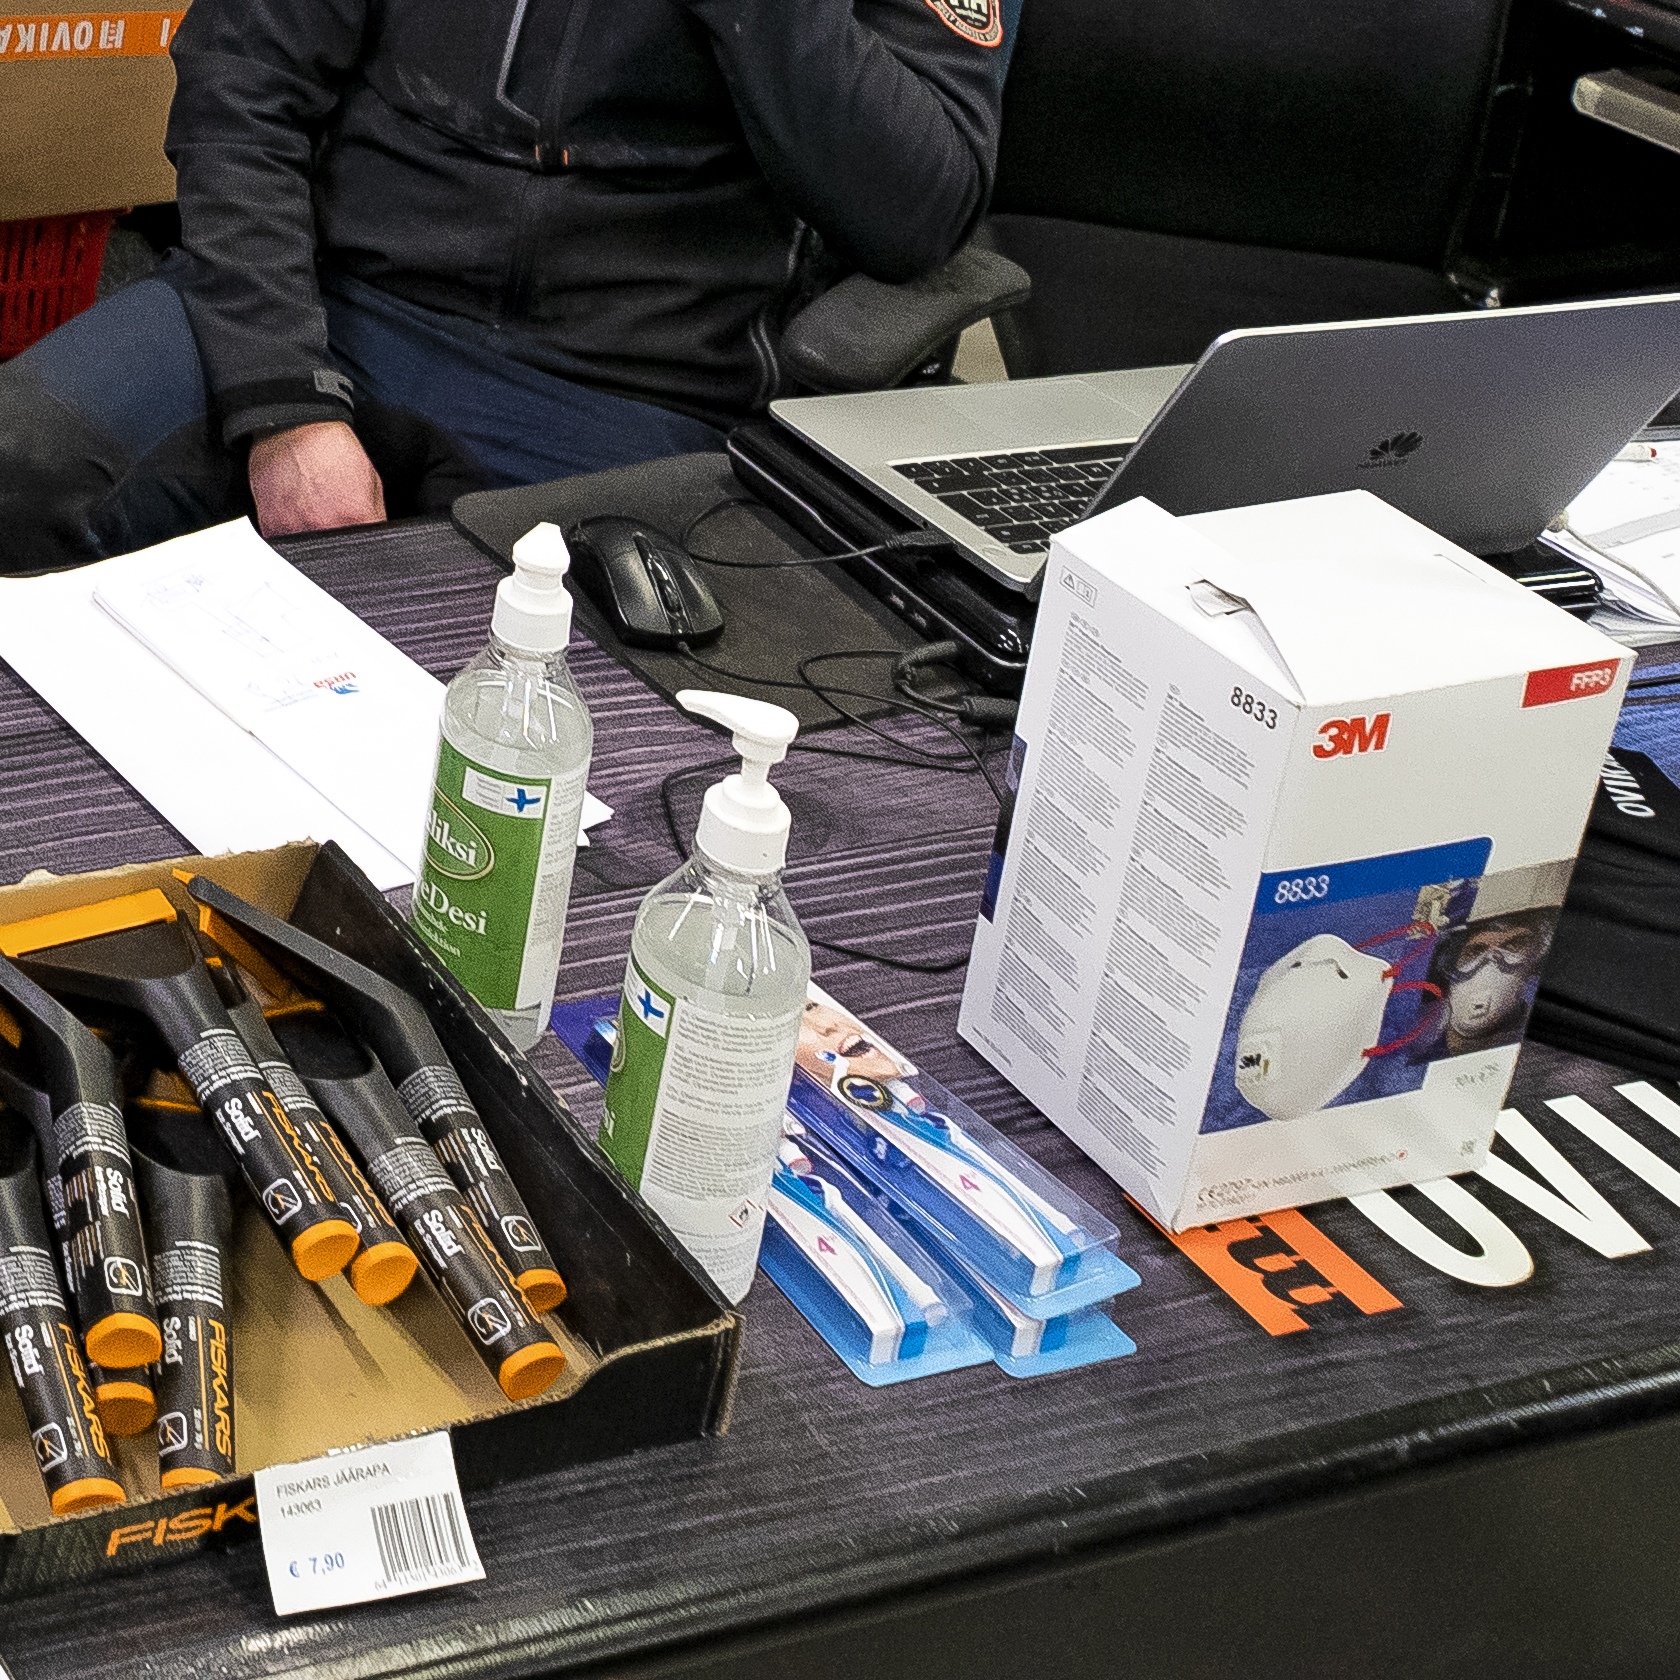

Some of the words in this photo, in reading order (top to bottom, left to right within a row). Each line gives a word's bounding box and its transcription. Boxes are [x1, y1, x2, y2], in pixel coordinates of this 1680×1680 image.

[1568, 666, 1614, 693] FFP3
[1229, 684, 1281, 731] 8833
[1311, 712, 1394, 761] 3M
[420, 880, 488, 936] eDesi
[1273, 873, 1331, 904] 8833
[224, 1097, 260, 1143] Solid
[104, 1167, 129, 1216] Solid
[13, 1324, 45, 1377] Solid
[58, 1323, 112, 1466] FISKARS
[163, 1316, 184, 1366] Solid
[208, 1318, 232, 1459] FISKARS
[275, 1475, 332, 1501] FISKARS
[333, 1460, 393, 1491] JÄÄRAPA
[106, 1495, 255, 1556] FISK
[289, 1559, 301, 1578] €
[308, 1551, 346, 1576] 7,90
